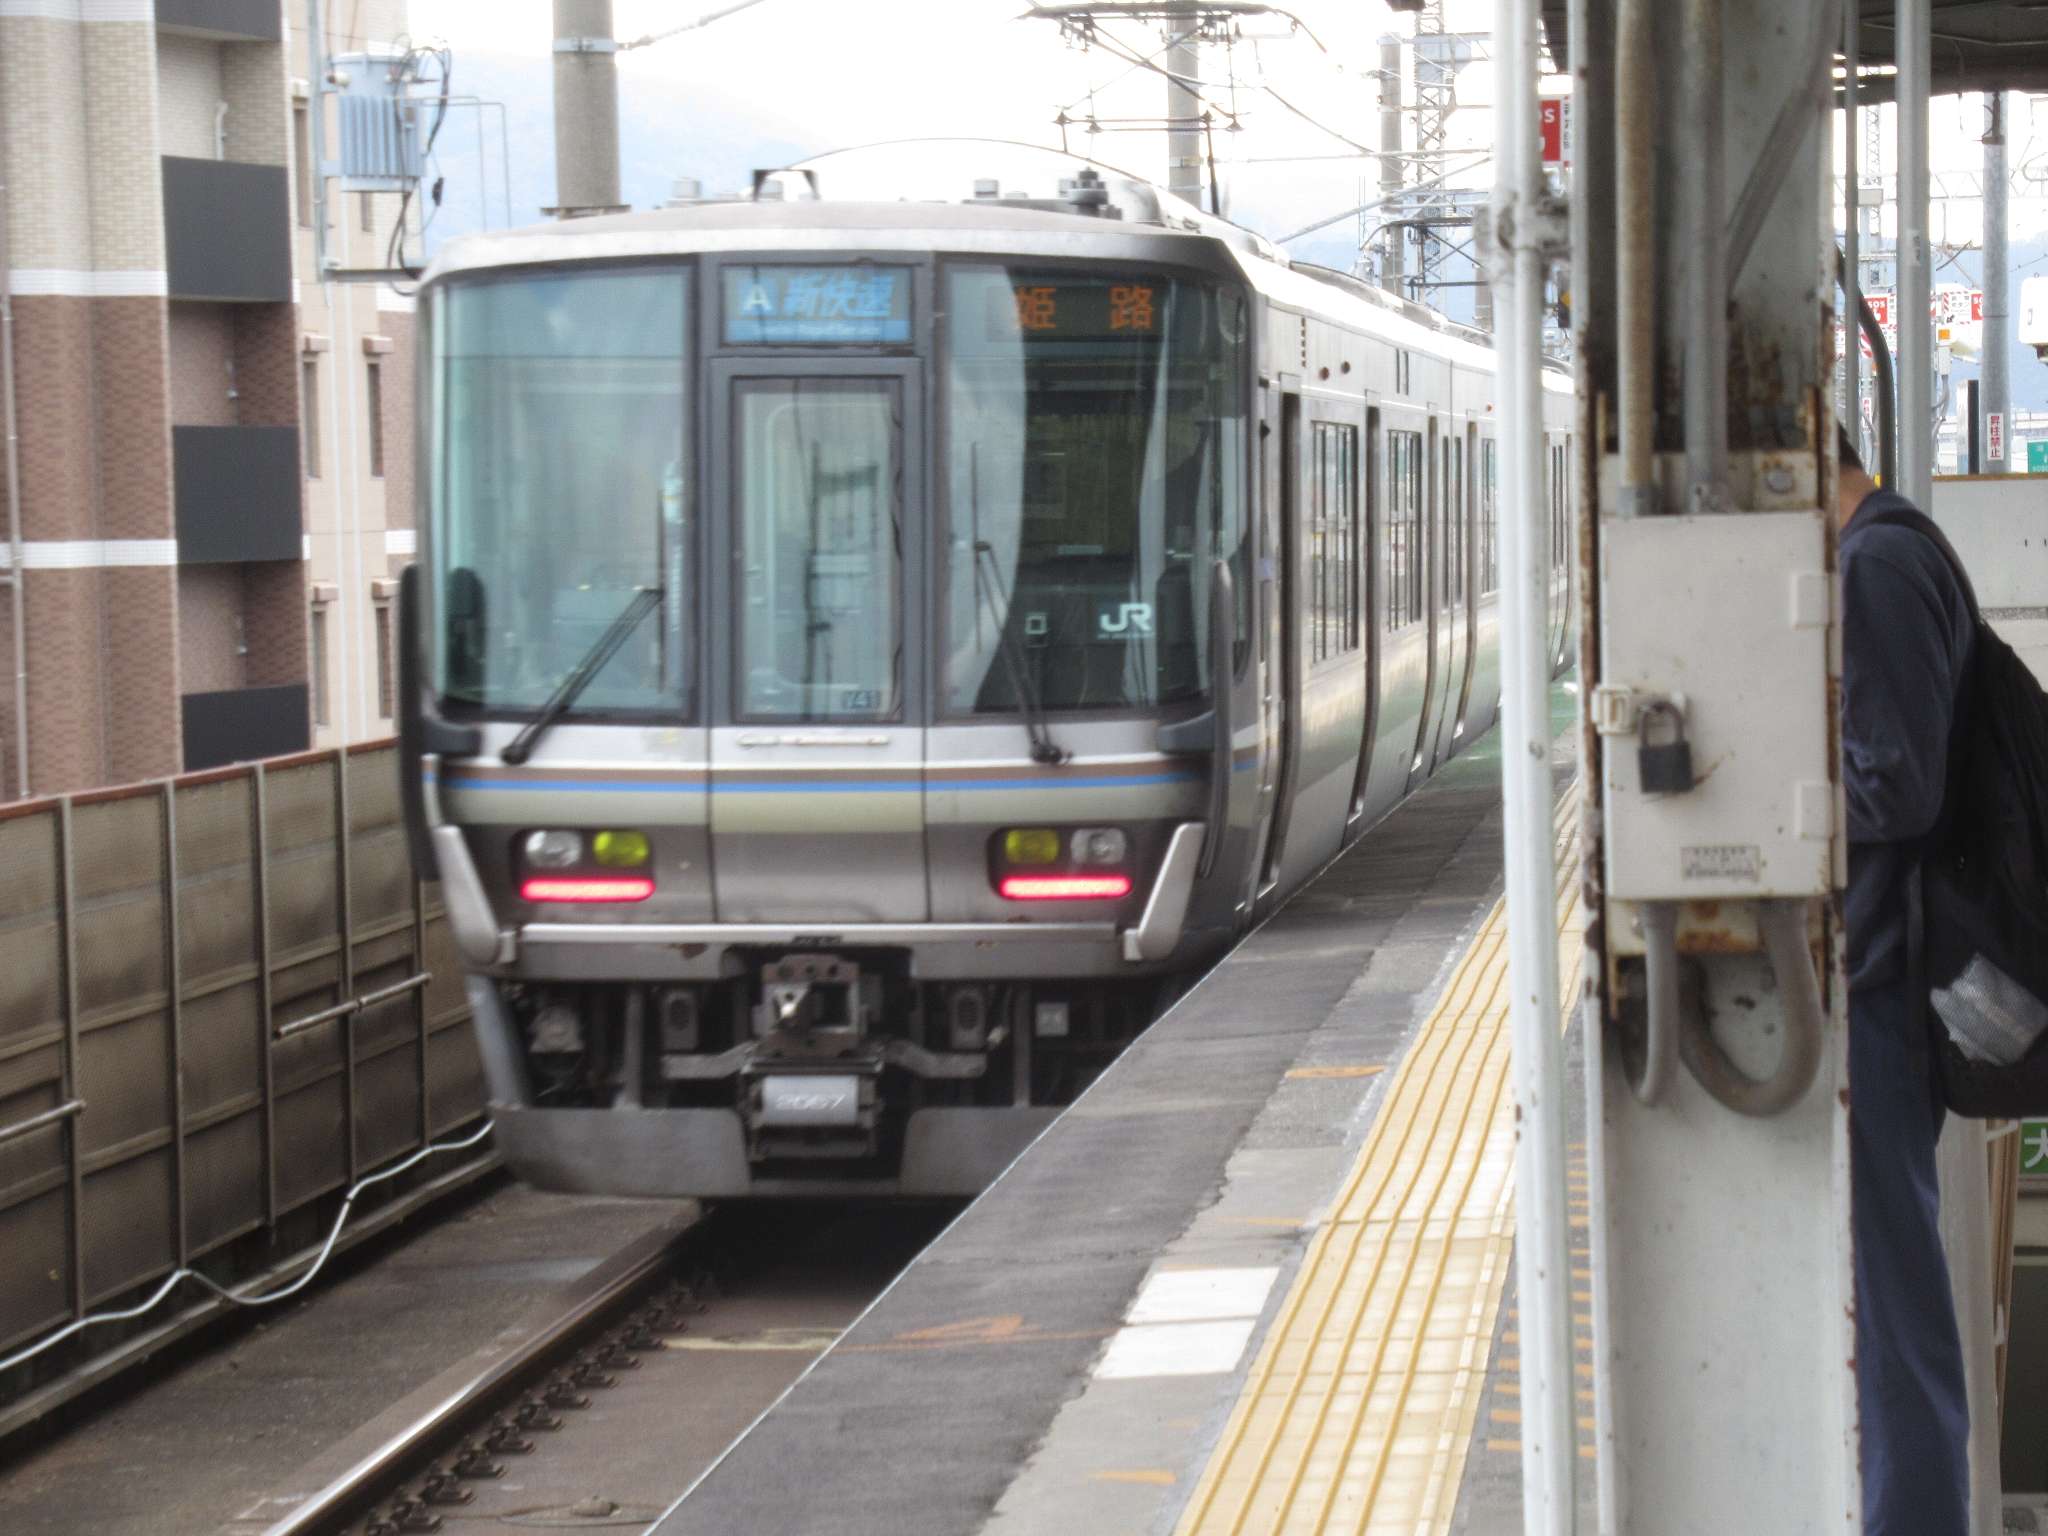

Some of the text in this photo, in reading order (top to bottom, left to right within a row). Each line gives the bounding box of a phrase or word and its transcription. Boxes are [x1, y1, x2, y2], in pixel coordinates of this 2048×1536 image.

[743, 284, 772, 312] A
[1016, 287, 1153, 330] 姫路
[1100, 603, 1153, 632] JR
